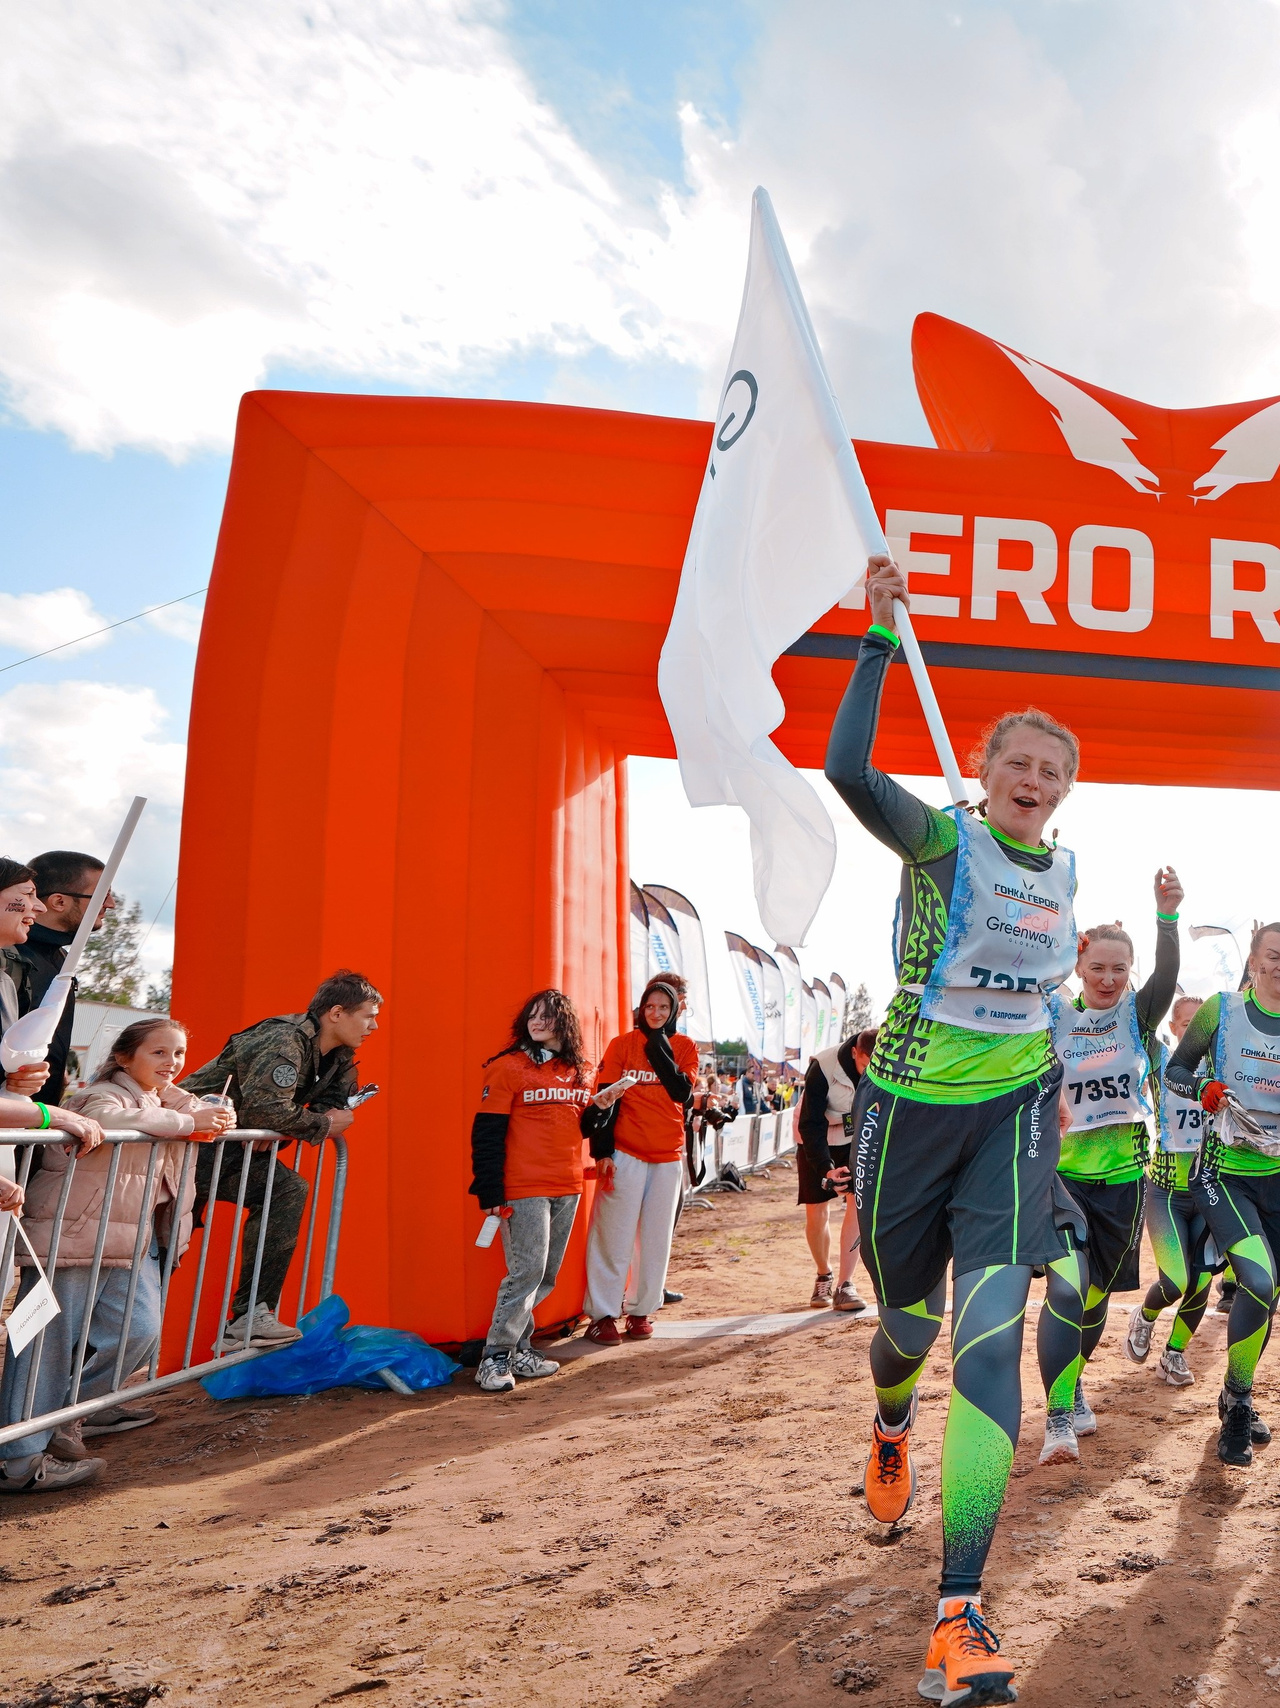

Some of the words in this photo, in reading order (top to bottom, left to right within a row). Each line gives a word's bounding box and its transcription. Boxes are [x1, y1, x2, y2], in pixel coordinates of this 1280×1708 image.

[838, 509, 1154, 633] ERO
[994, 883, 1025, 901] ГОНКА
[1027, 893, 1060, 912] ГЕРОЕВ
[1005, 901, 1050, 932] Олеся
[986, 916, 1054, 949] Greenway
[1008, 938, 1040, 950] GLOBAL
[990, 1010, 1028, 1020] ГАЗПРОМБАНК
[1063, 1044, 1118, 1060] Greenway
[1241, 1048, 1266, 1058] ГОНКА
[1069, 1073, 1130, 1105] 7353
[855, 1112, 879, 1210] Greenway
[867, 1140, 879, 1185] GLOBAL
